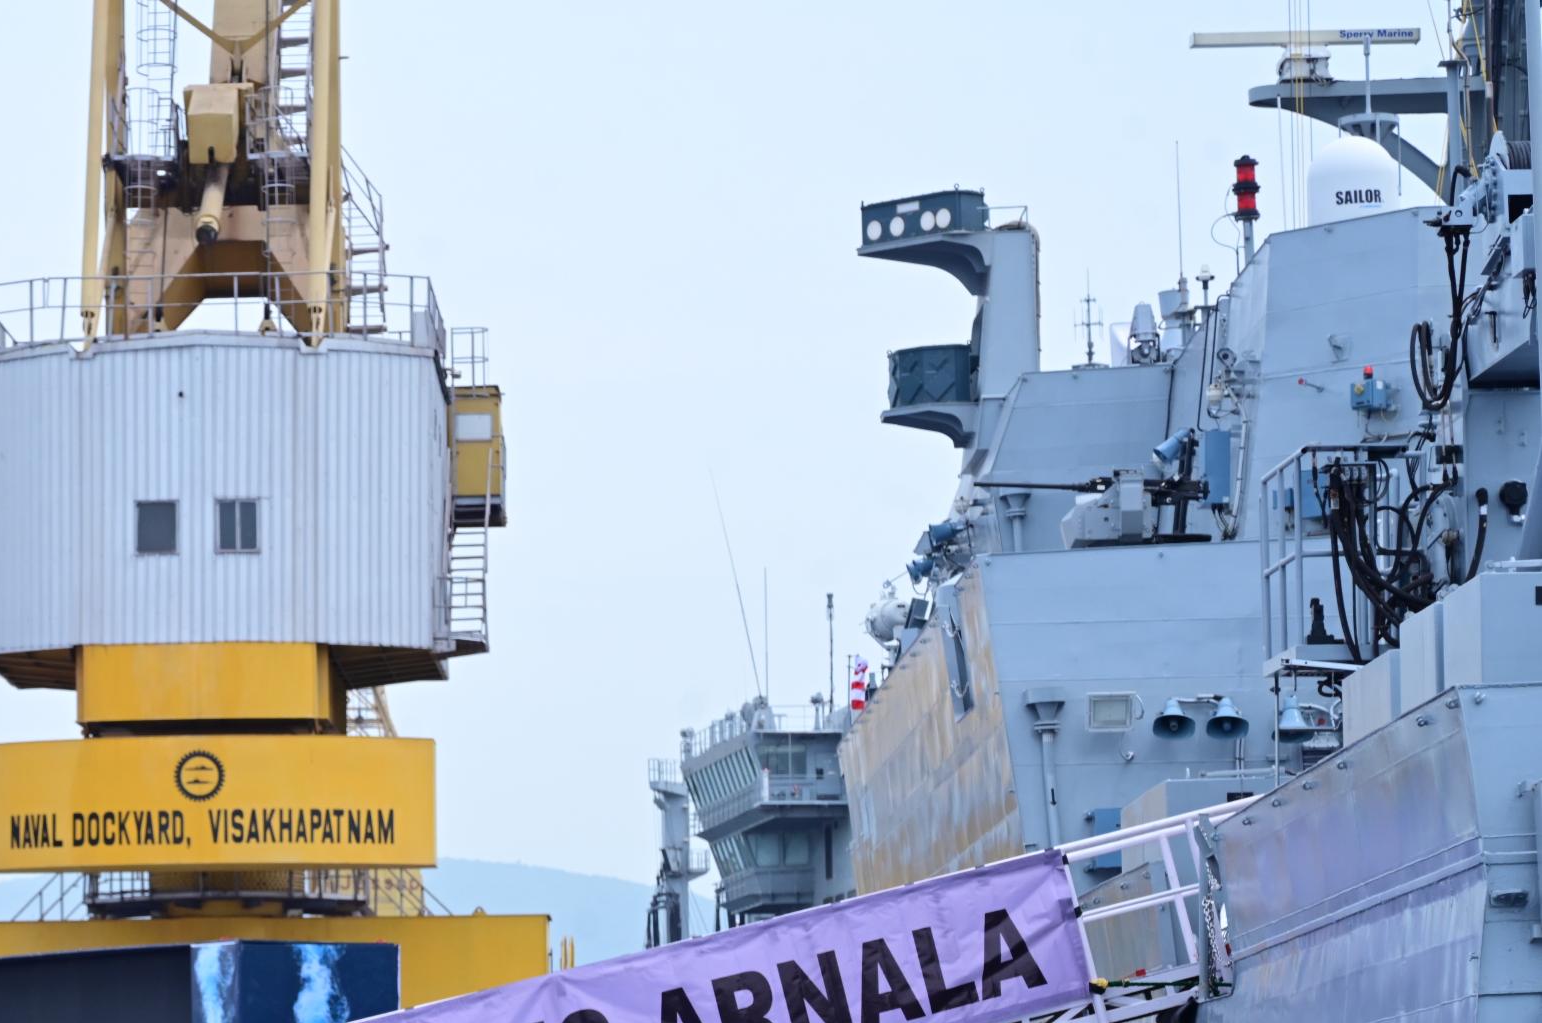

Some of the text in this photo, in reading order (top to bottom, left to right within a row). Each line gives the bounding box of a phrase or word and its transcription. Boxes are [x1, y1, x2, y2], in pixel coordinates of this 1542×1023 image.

[1377, 28, 1414, 38] Marine
[1335, 189, 1382, 205] SAILOR
[10, 808, 394, 849] NAVAL DOCKYARD, VISAKHAPATNAM
